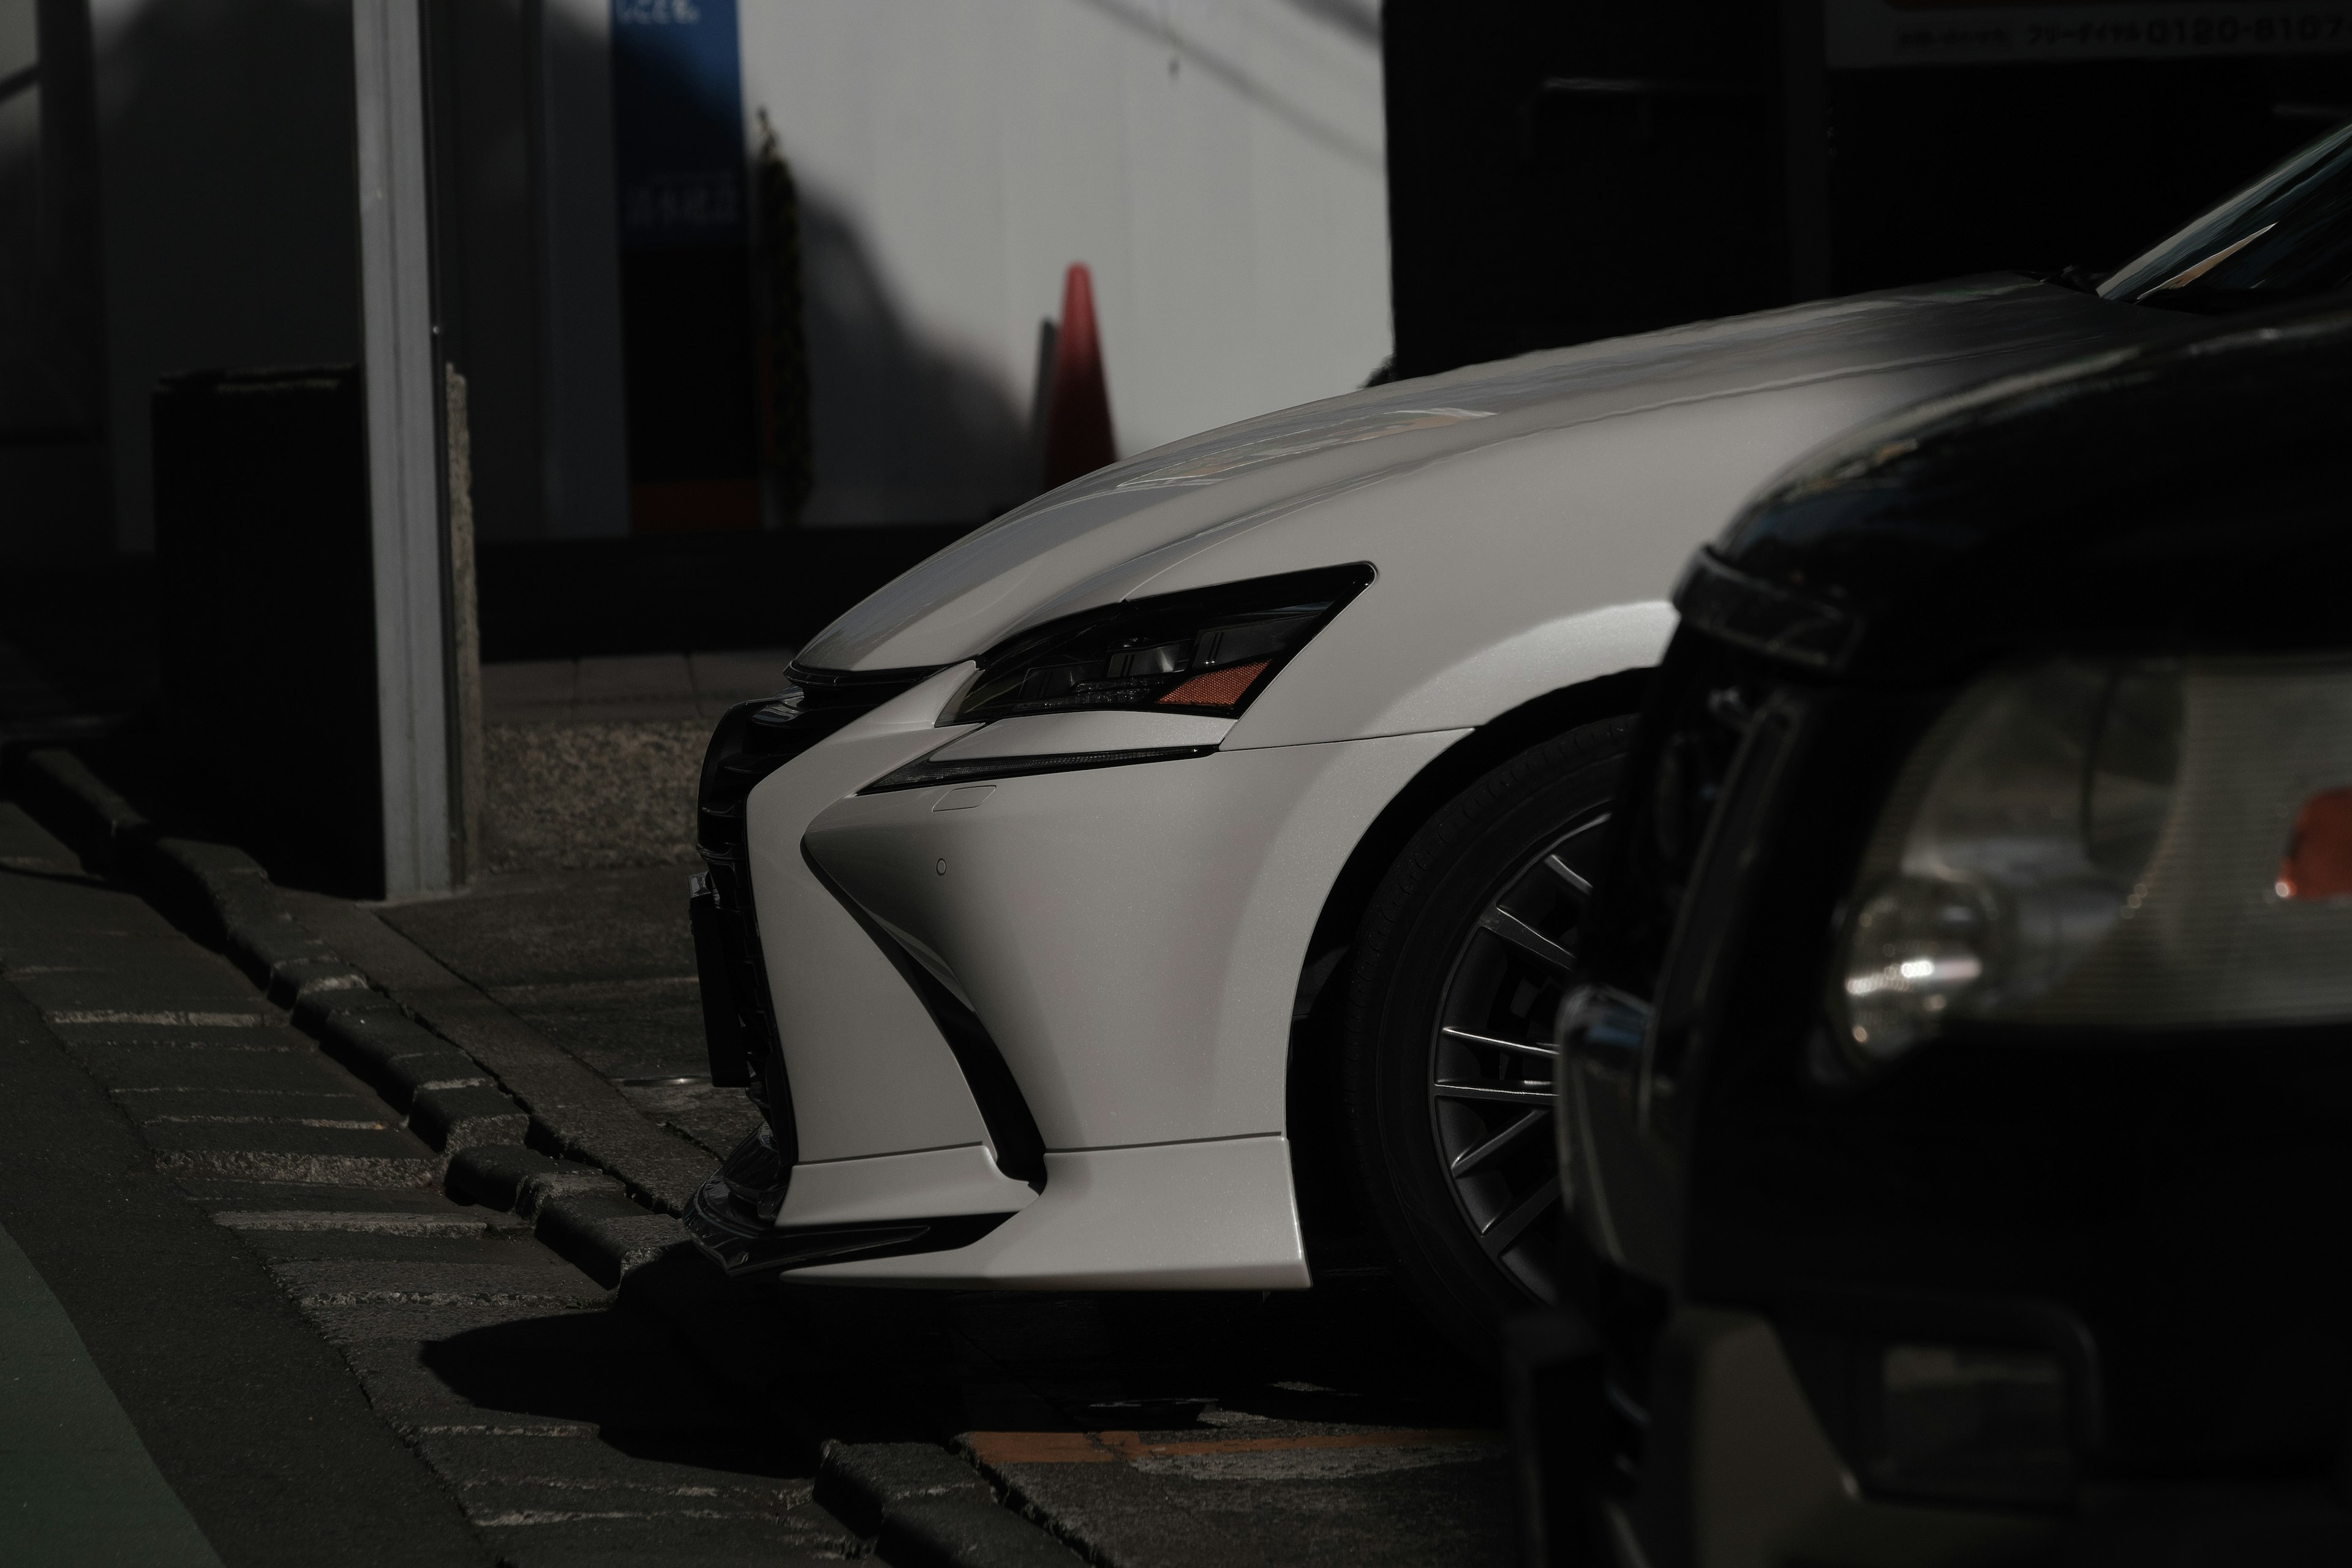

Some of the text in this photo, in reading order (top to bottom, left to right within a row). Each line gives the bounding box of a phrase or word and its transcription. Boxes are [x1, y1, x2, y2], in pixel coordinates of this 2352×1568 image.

[2026, 20, 2141, 45] フリーダイヤル
